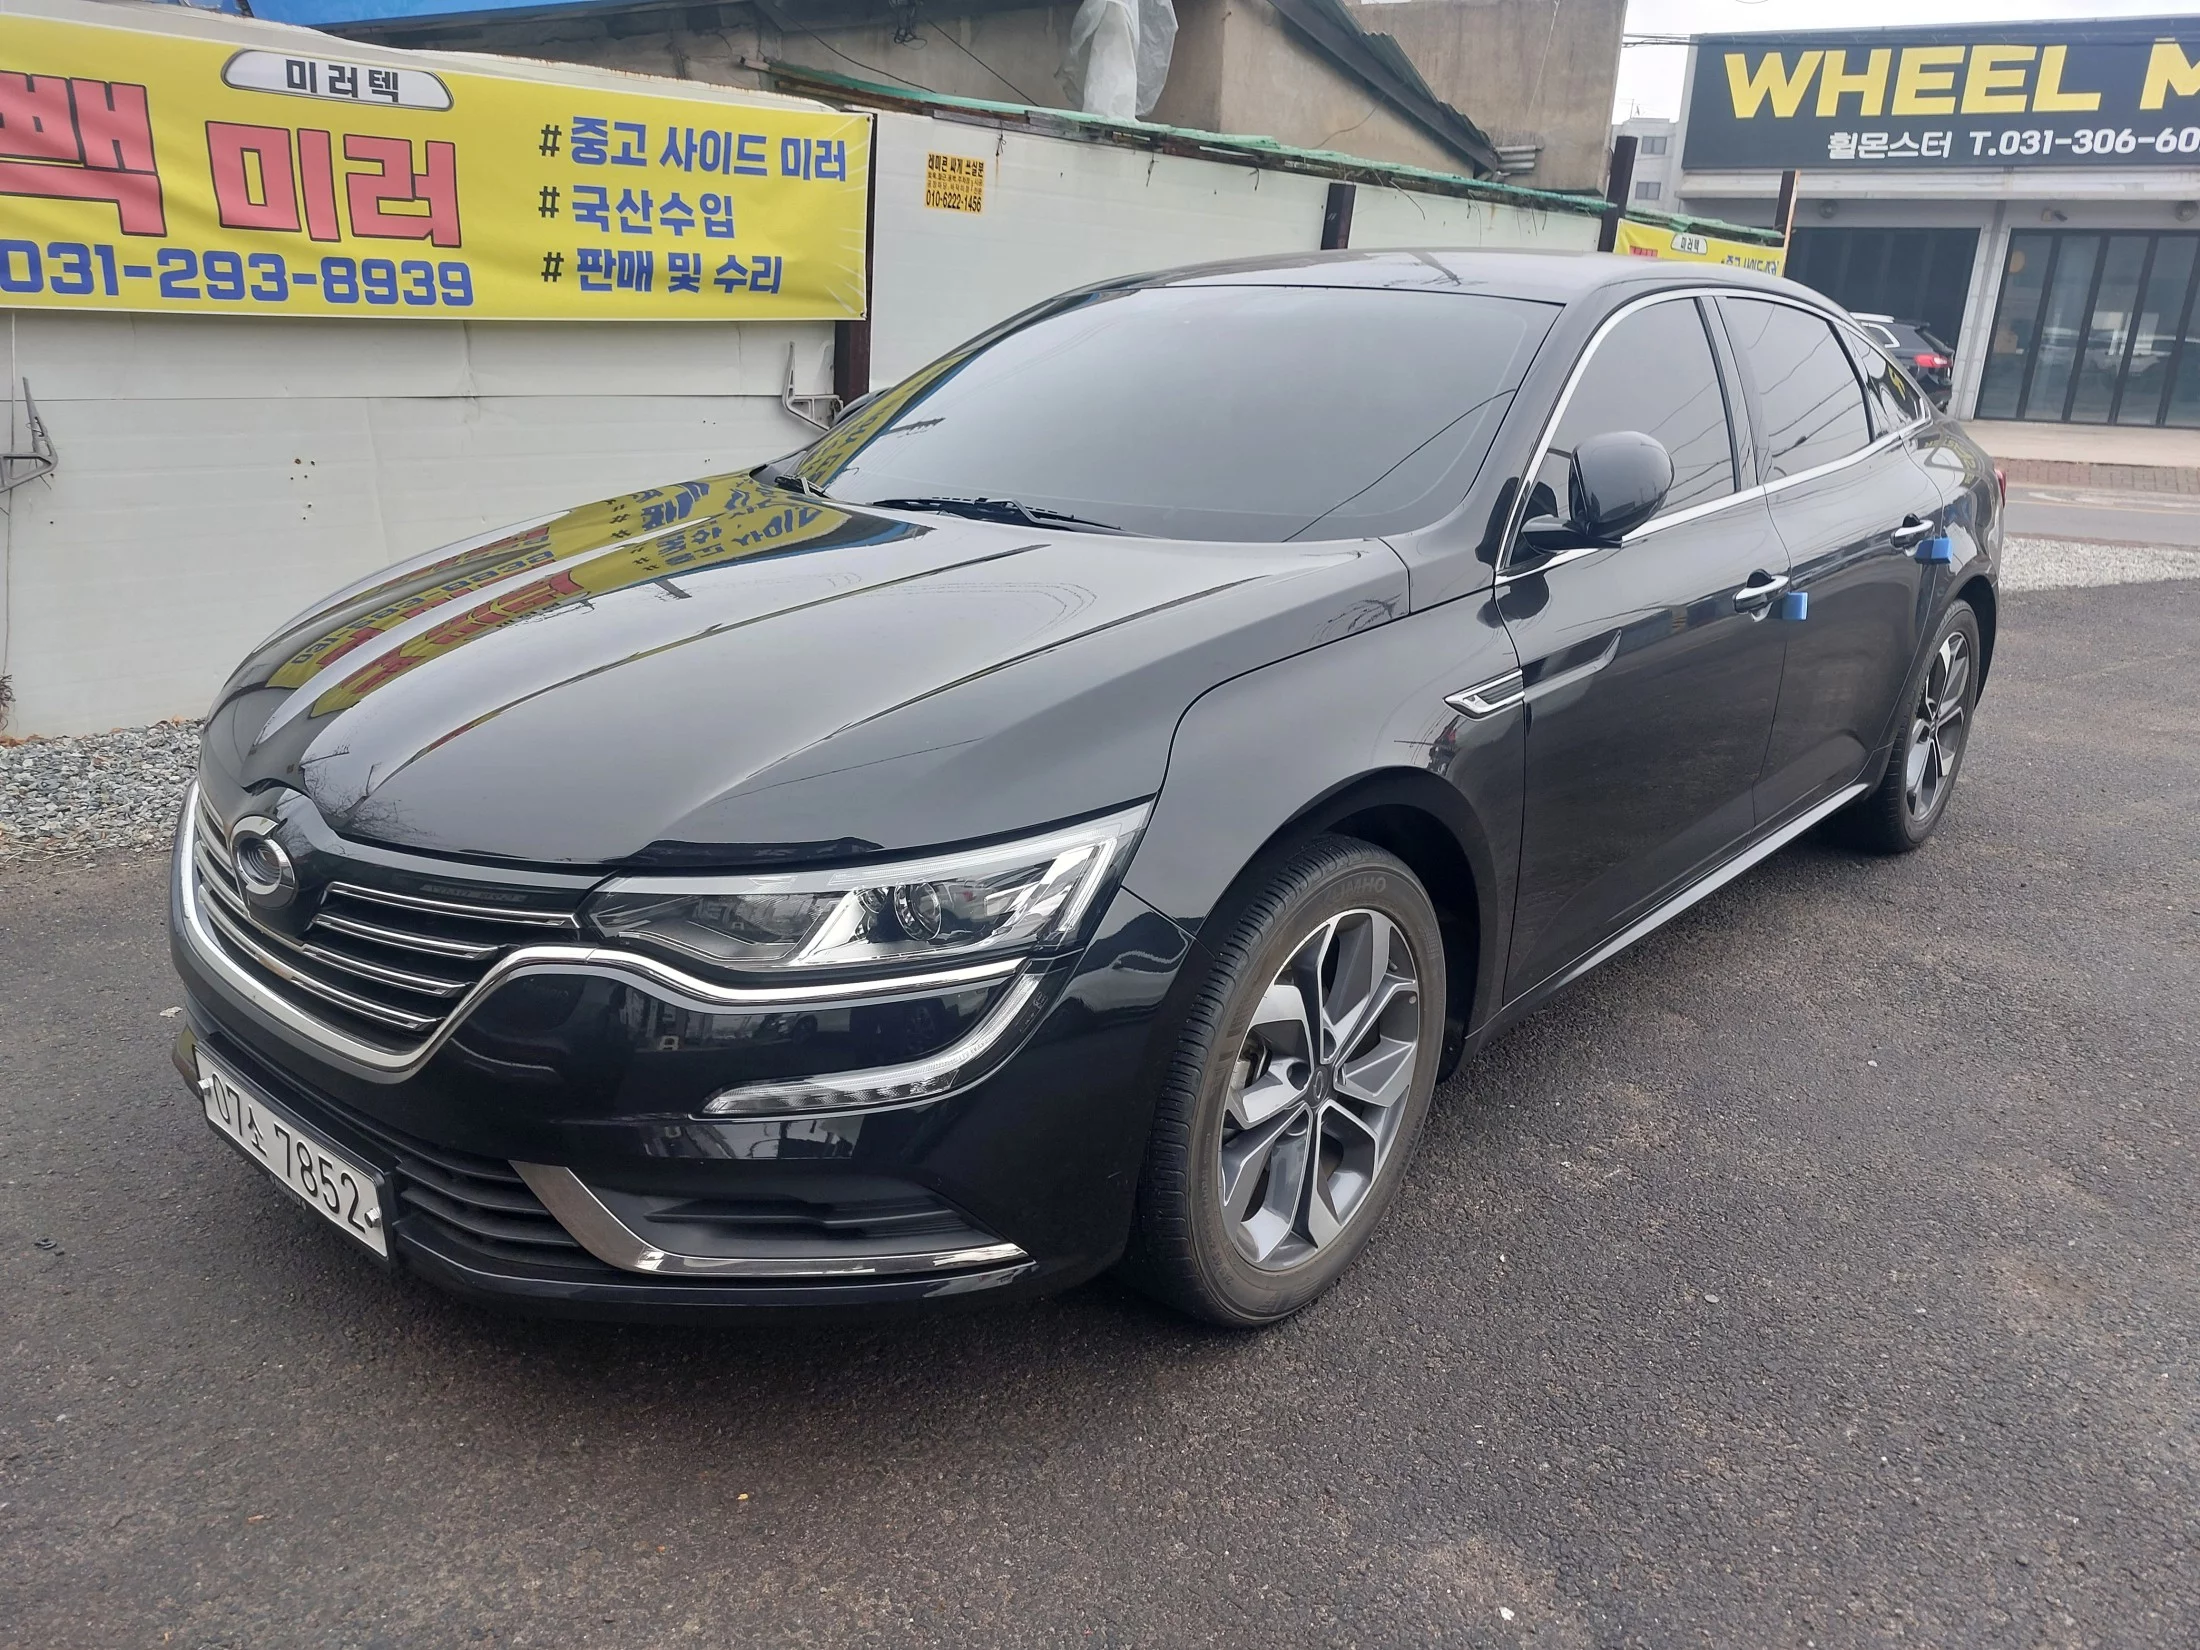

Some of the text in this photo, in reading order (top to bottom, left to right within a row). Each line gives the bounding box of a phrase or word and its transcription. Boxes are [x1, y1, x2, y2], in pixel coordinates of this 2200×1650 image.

[286, 58, 399, 103] 미러텍
[1724, 45, 2101, 119] WHEEL
[659, 126, 769, 177] 사이드
[780, 136, 847, 183] 미러
[1827, 127, 2200, 160] 휠몬스터 T.031-306-60
[205, 120, 462, 248] 미러
[926, 189, 982, 212] 010-6222-1456
[0, 239, 474, 307] 031-293-8939
[667, 252, 700, 294] 및
[713, 254, 783, 295] 수리
[212, 1072, 366, 1234] 07소 7852
